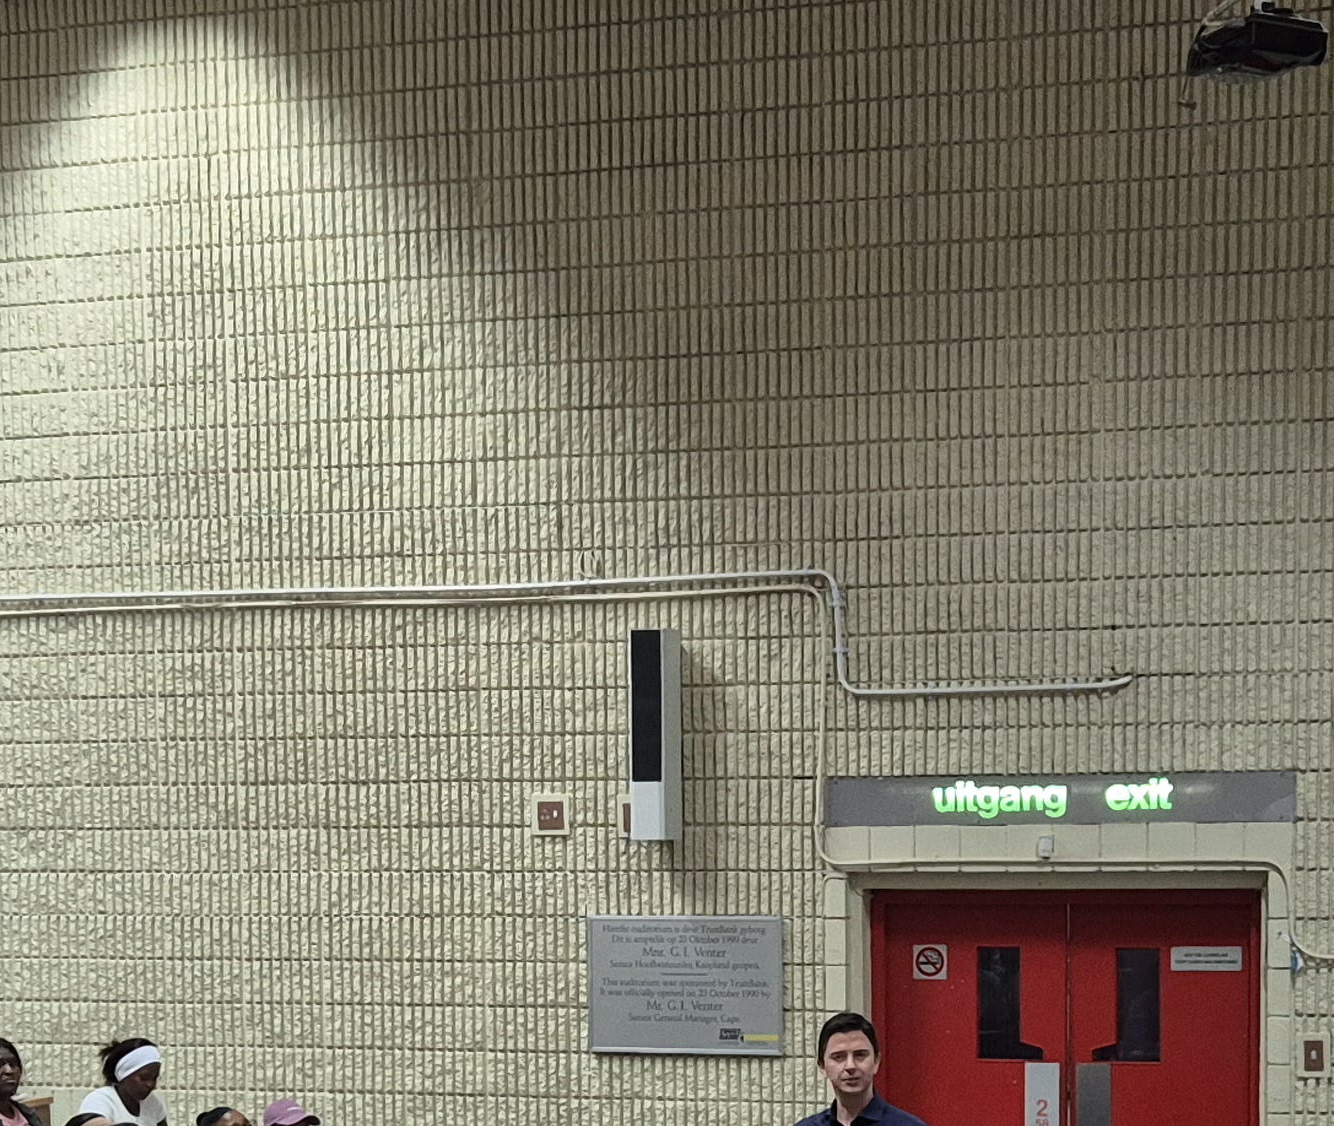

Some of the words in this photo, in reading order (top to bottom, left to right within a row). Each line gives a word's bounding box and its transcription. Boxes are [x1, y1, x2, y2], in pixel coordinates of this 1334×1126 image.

[931, 780, 1068, 819] uitgang
[1104, 778, 1174, 811] exit
[694, 947, 727, 958] Venter
[602, 978, 618, 987] This
[679, 979, 717, 989] sponsored
[718, 979, 729, 989] by
[624, 989, 655, 998] officially
[658, 989, 685, 998] opened
[710, 989, 739, 998] October
[761, 990, 771, 999] by
[692, 1001, 723, 1011] Venter
[654, 1014, 682, 1022] General
[1036, 1099, 1048, 1117] 2
